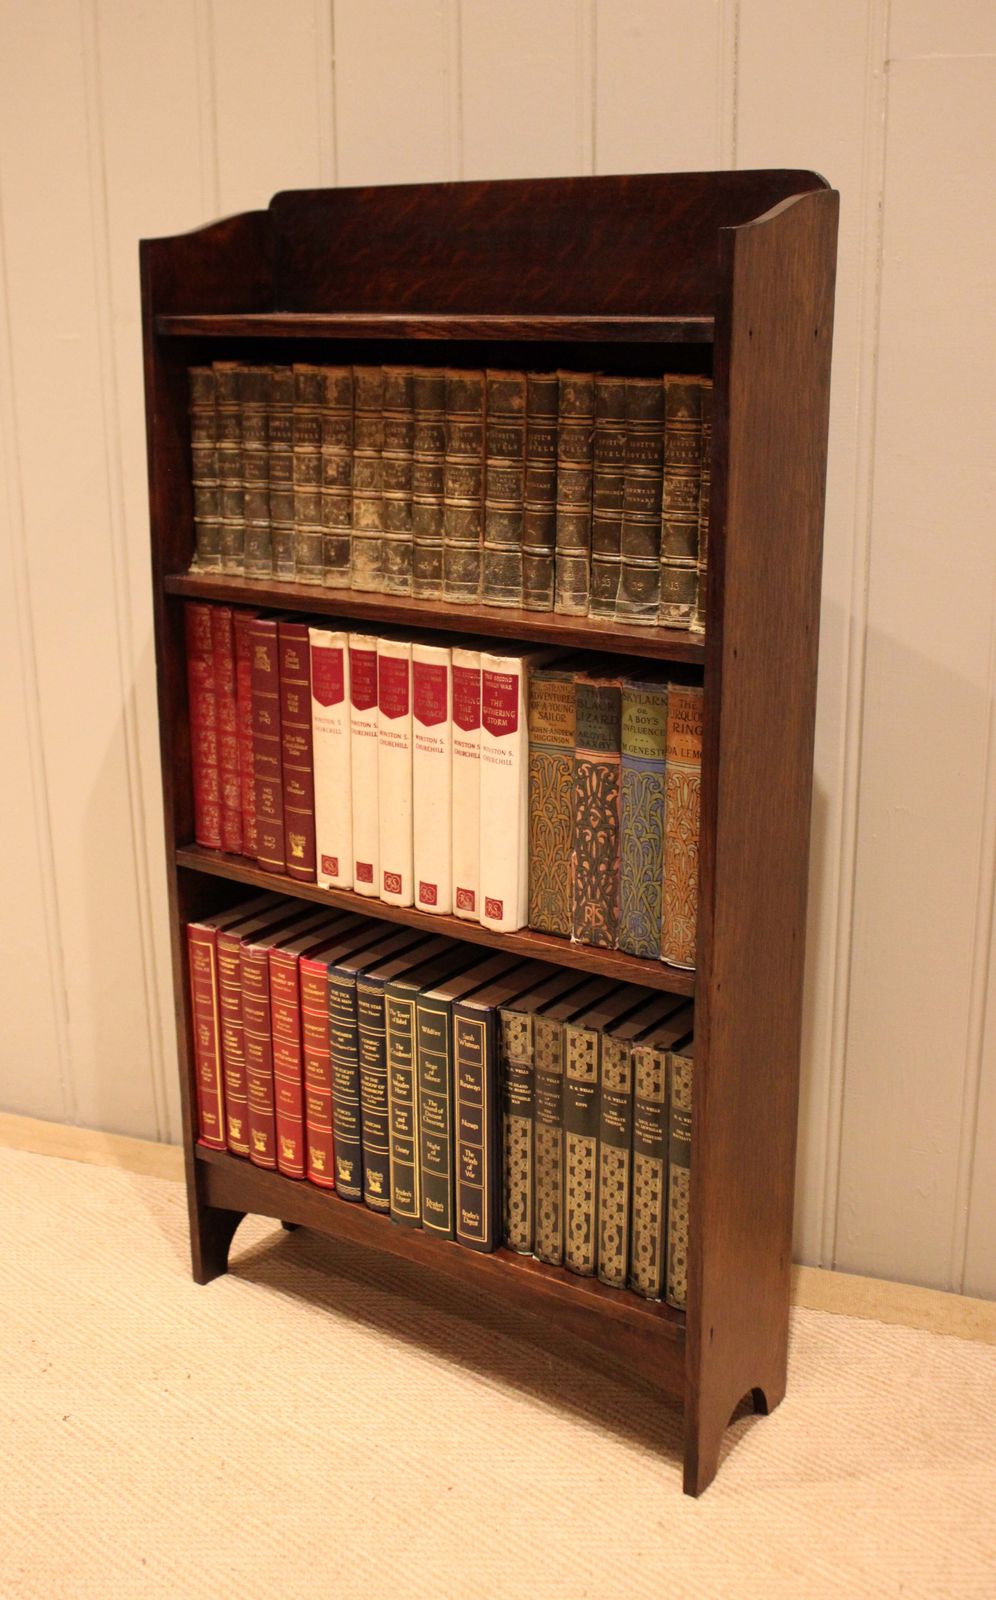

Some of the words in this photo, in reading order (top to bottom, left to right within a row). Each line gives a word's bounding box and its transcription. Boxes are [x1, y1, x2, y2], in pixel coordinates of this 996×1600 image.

[490, 699, 503, 708] THE
[549, 703, 574, 714] YOUNG
[679, 699, 698, 710] THE
[483, 706, 516, 718] GATHERING
[538, 712, 567, 722] SAILOR
[670, 708, 704, 723] URQUOI
[487, 717, 508, 726] STORM
[576, 710, 620, 725] LIZARD
[628, 714, 634, 723] A
[672, 722, 704, 736] RING
[380, 730, 402, 740] WINSTON
[416, 734, 438, 744] WINSTON
[534, 734, 570, 744] HIGGINSON
[379, 739, 408, 749] CHURCHILL
[416, 743, 444, 754] CHURCHILL
[454, 740, 476, 749] WINSTON
[454, 748, 480, 759] CHURCHILL
[483, 746, 506, 756] WINSTON
[482, 754, 513, 766] CHURCHILL
[464, 1074, 475, 1083] The
[612, 1096, 627, 1104] WELLS
[464, 1149, 476, 1158] The
[462, 1155, 479, 1166] Winds
[464, 1170, 476, 1179] War
[462, 1209, 480, 1221] Reader's
